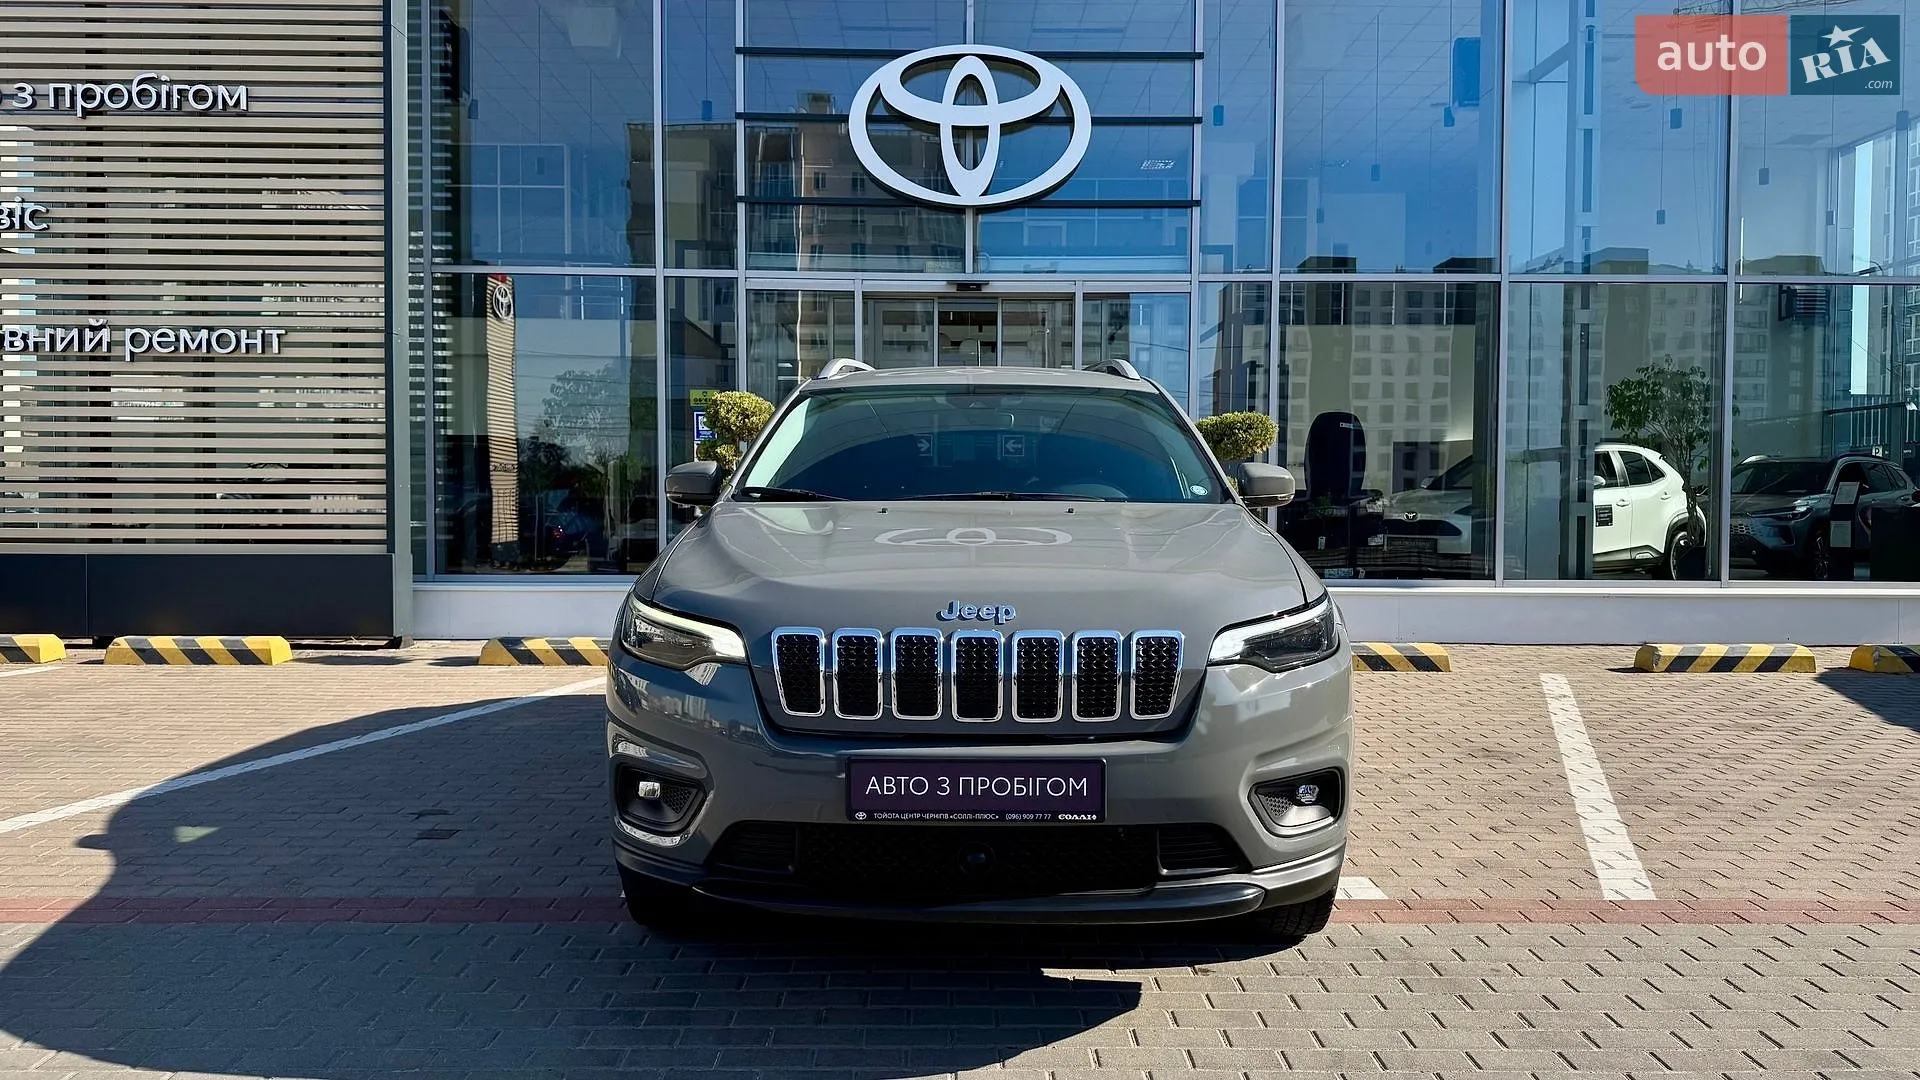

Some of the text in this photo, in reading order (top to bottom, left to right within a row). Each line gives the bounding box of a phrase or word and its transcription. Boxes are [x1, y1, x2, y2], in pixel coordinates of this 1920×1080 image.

[12, 72, 249, 119] з пробігом
[124, 327, 287, 362] ремонт
[938, 600, 1017, 625] Jeep
[865, 776, 1087, 797] АВТО З ПРОБІГОМ
